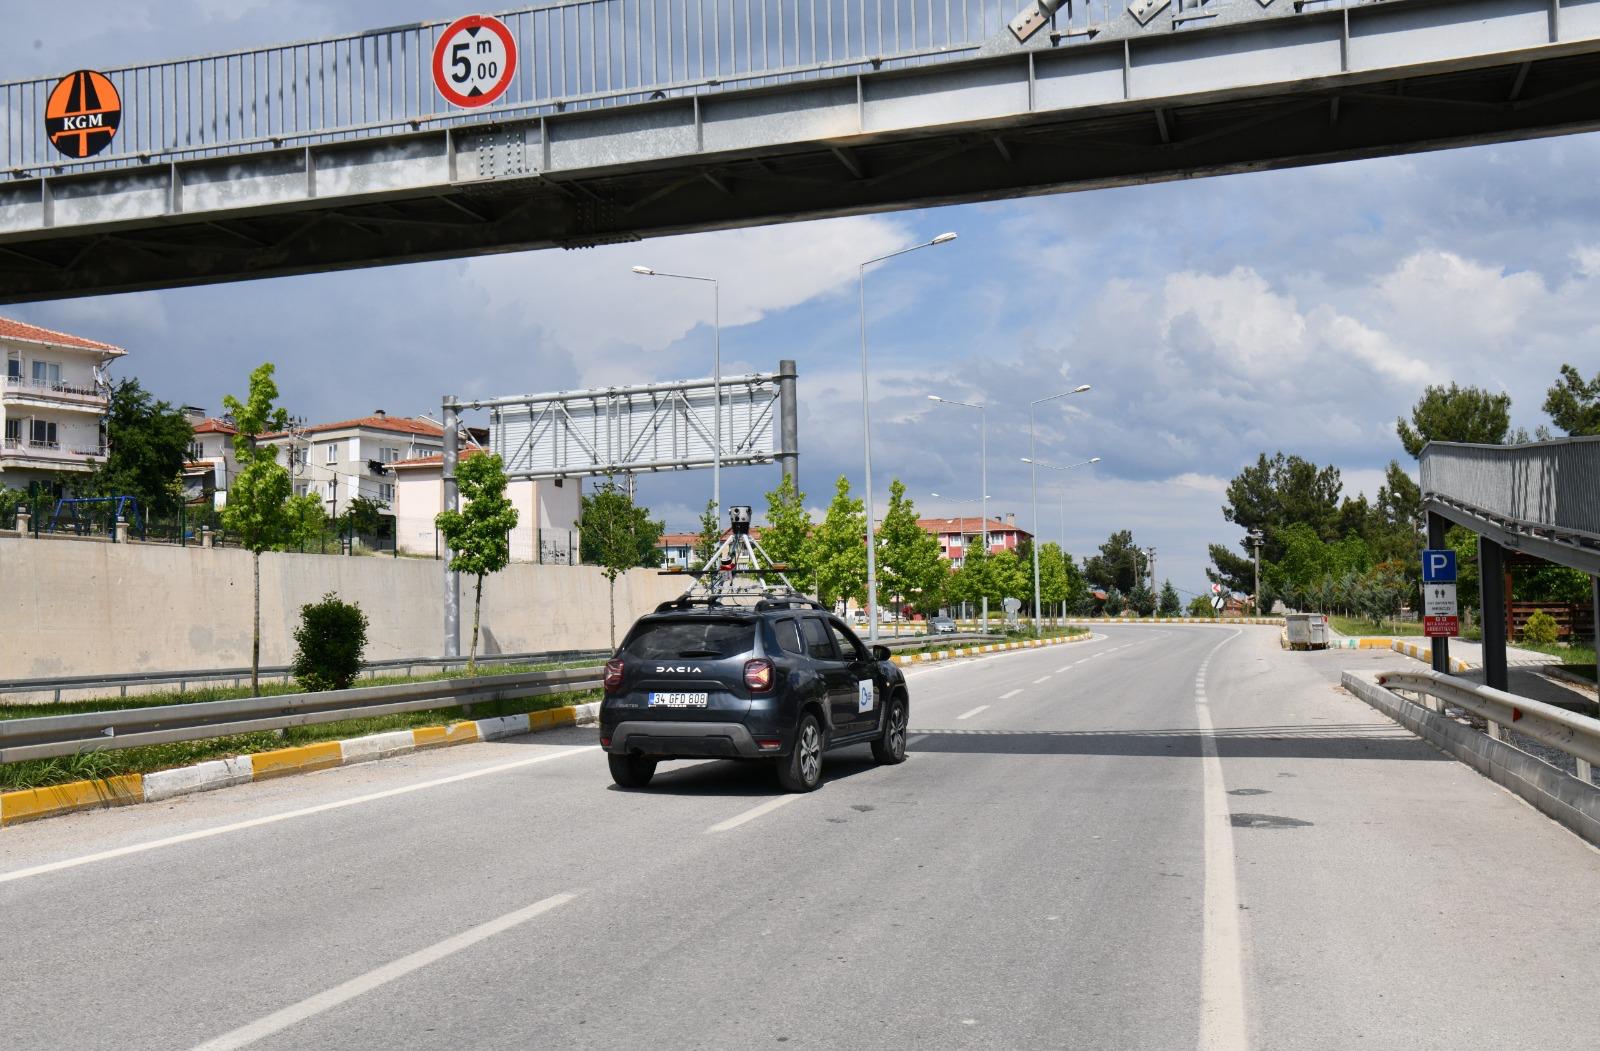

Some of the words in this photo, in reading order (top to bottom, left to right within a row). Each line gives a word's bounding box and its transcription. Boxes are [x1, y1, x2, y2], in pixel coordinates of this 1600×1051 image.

[451, 42, 472, 83] 5
[477, 40, 492, 54] m
[477, 61, 498, 80] 00
[63, 113, 103, 131] KGM
[1430, 554, 1448, 578] P
[655, 693, 666, 704] 34
[669, 693, 686, 704] GFD
